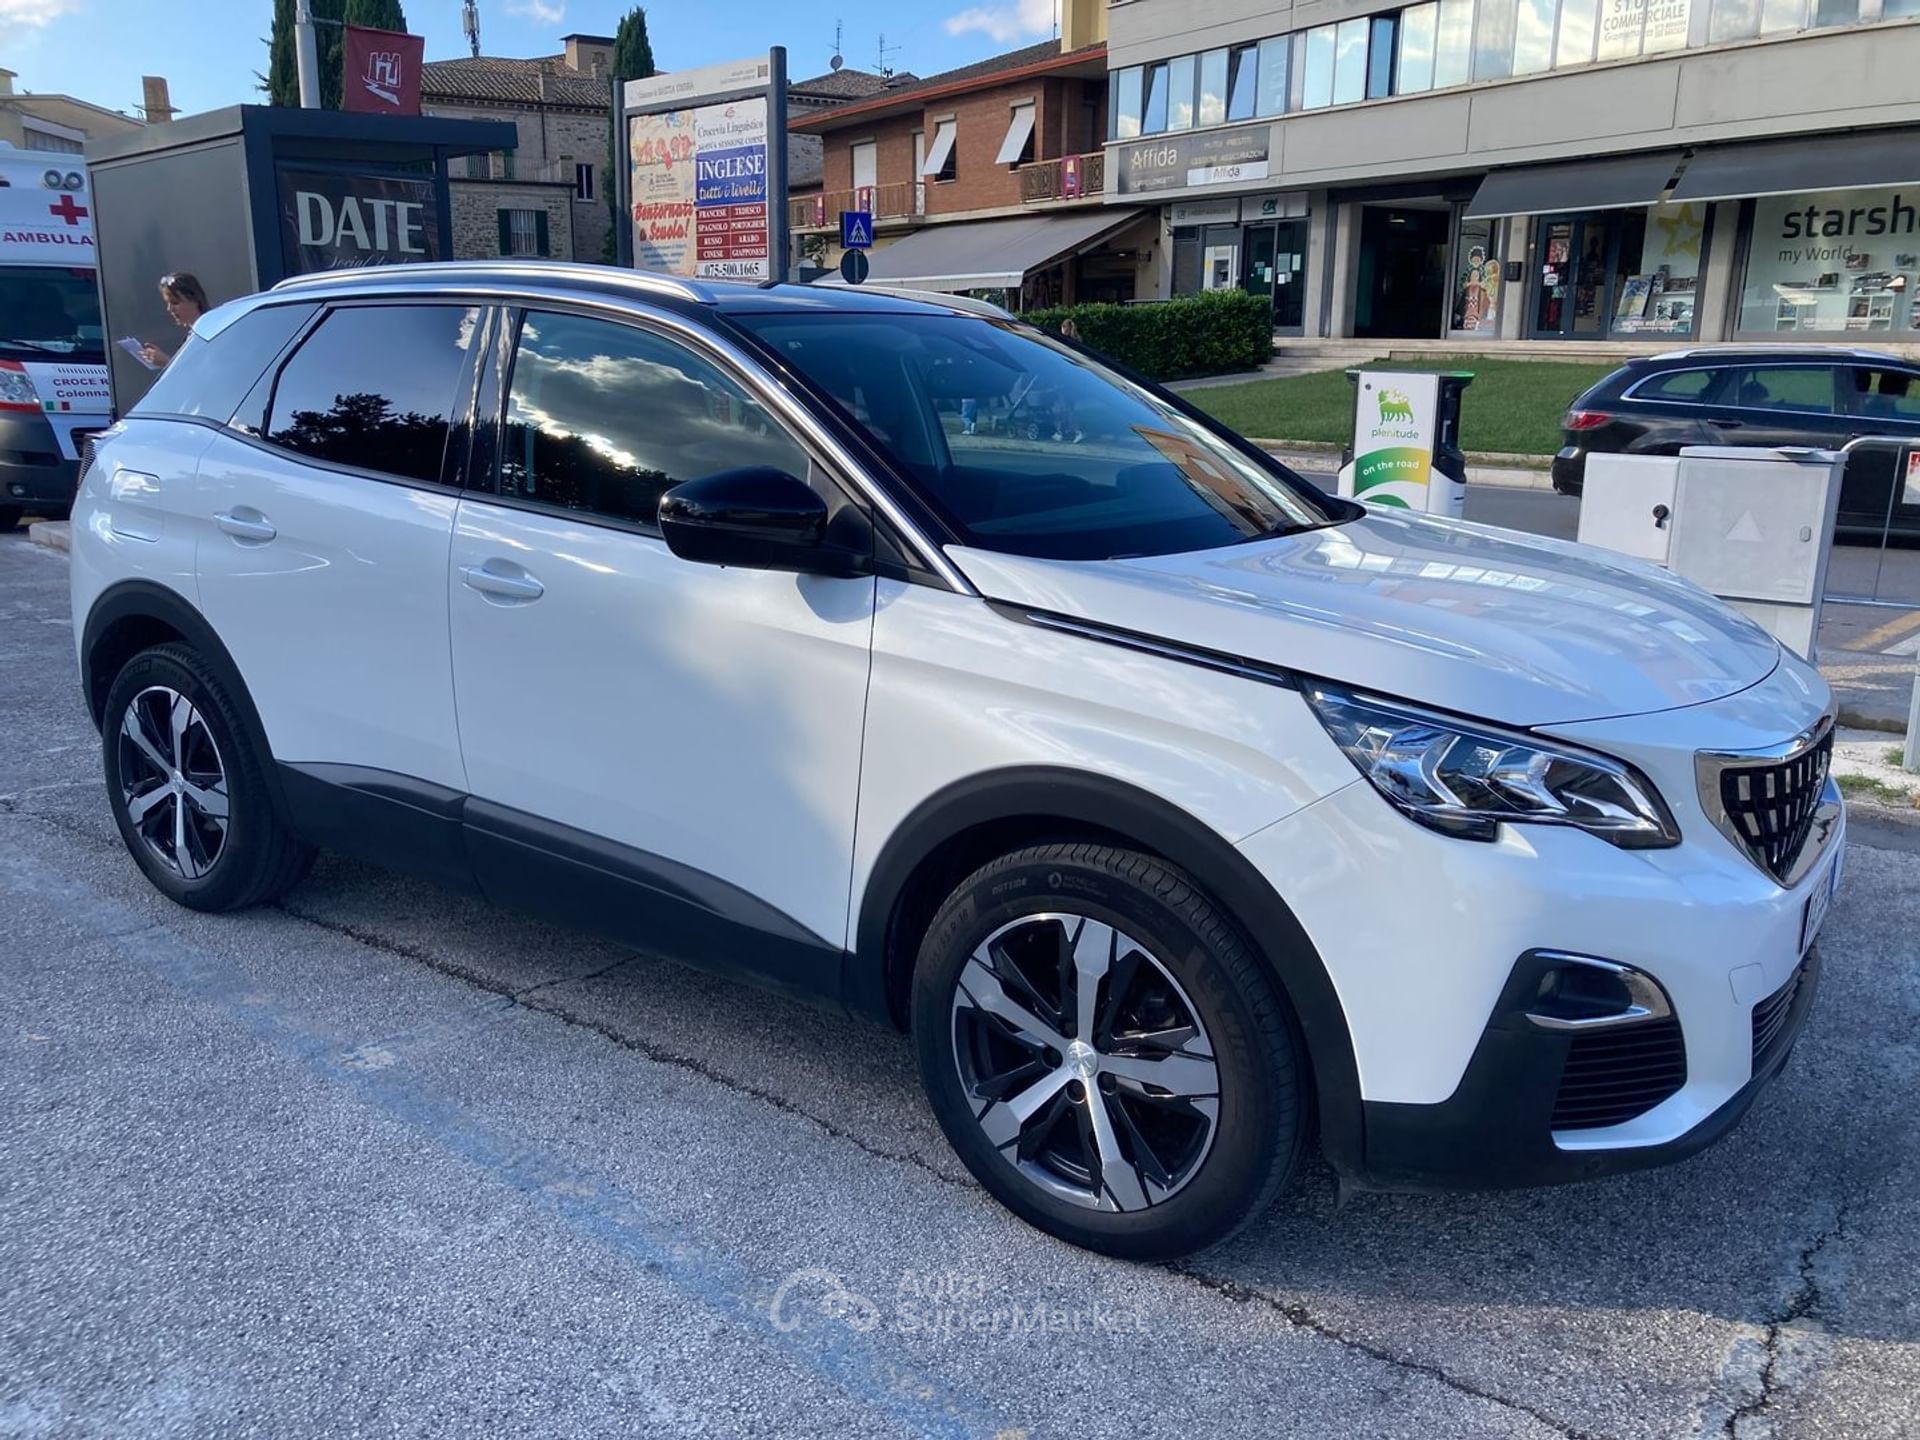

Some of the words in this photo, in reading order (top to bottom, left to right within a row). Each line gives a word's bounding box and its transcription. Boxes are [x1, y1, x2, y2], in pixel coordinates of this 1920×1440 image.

[1603, 4, 1685, 31] COMMERCIALE
[699, 154, 764, 181] INGLESE
[1131, 146, 1178, 170] Affida
[699, 186, 722, 200] tutti
[731, 180, 765, 198] livelli
[698, 208, 728, 218] FRANCESE
[735, 206, 761, 216] TEDESCO
[1781, 194, 1920, 239] starsh
[296, 190, 425, 253] DATE
[649, 218, 690, 241] Scuola!
[698, 222, 728, 232] SPAGNOLO
[3, 231, 96, 246] AMBULA
[1779, 250, 1801, 265] my
[1806, 245, 1853, 262] World
[52, 378, 96, 387] CROCE
[1371, 428, 1419, 439] plenitude
[1362, 466, 1376, 477] on
[1377, 460, 1394, 471] the
[1396, 459, 1420, 470] road
